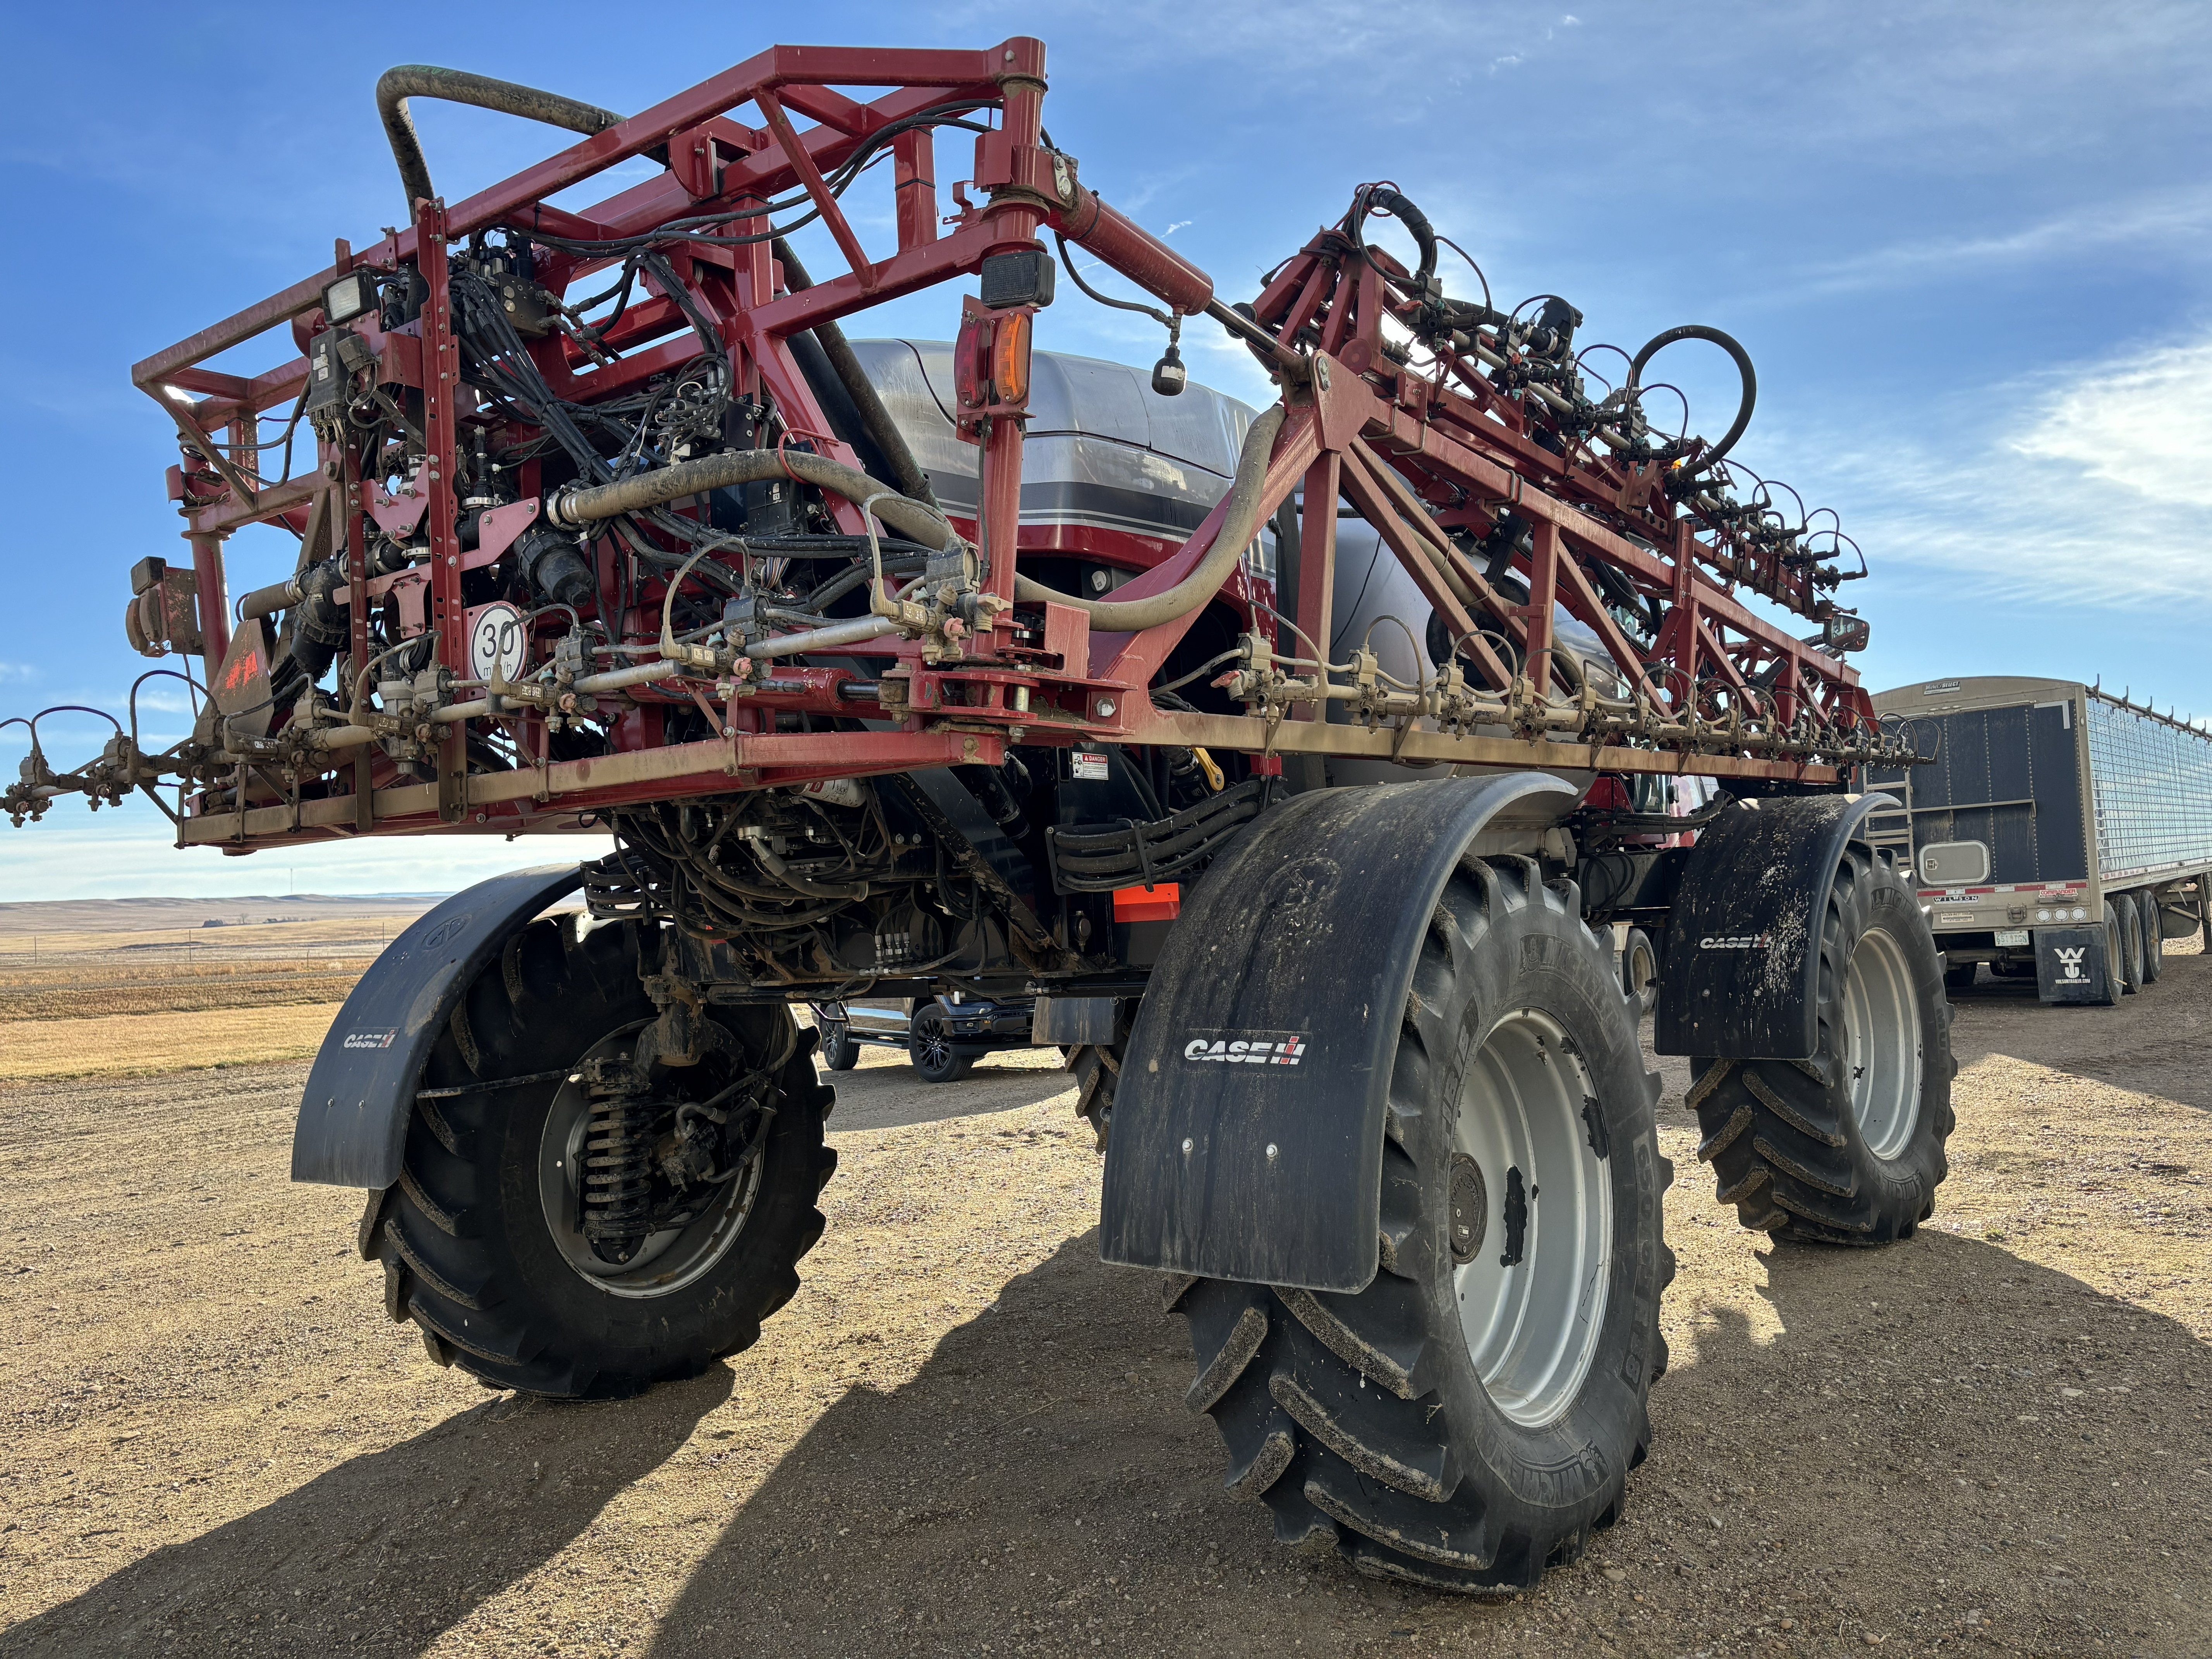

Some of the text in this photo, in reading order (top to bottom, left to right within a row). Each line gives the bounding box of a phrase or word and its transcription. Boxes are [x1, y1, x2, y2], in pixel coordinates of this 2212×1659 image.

[483, 621, 514, 658] 30
[1700, 937, 1753, 949] CASE
[344, 1034, 383, 1048] CASE
[1185, 1039, 1273, 1063] CASE
